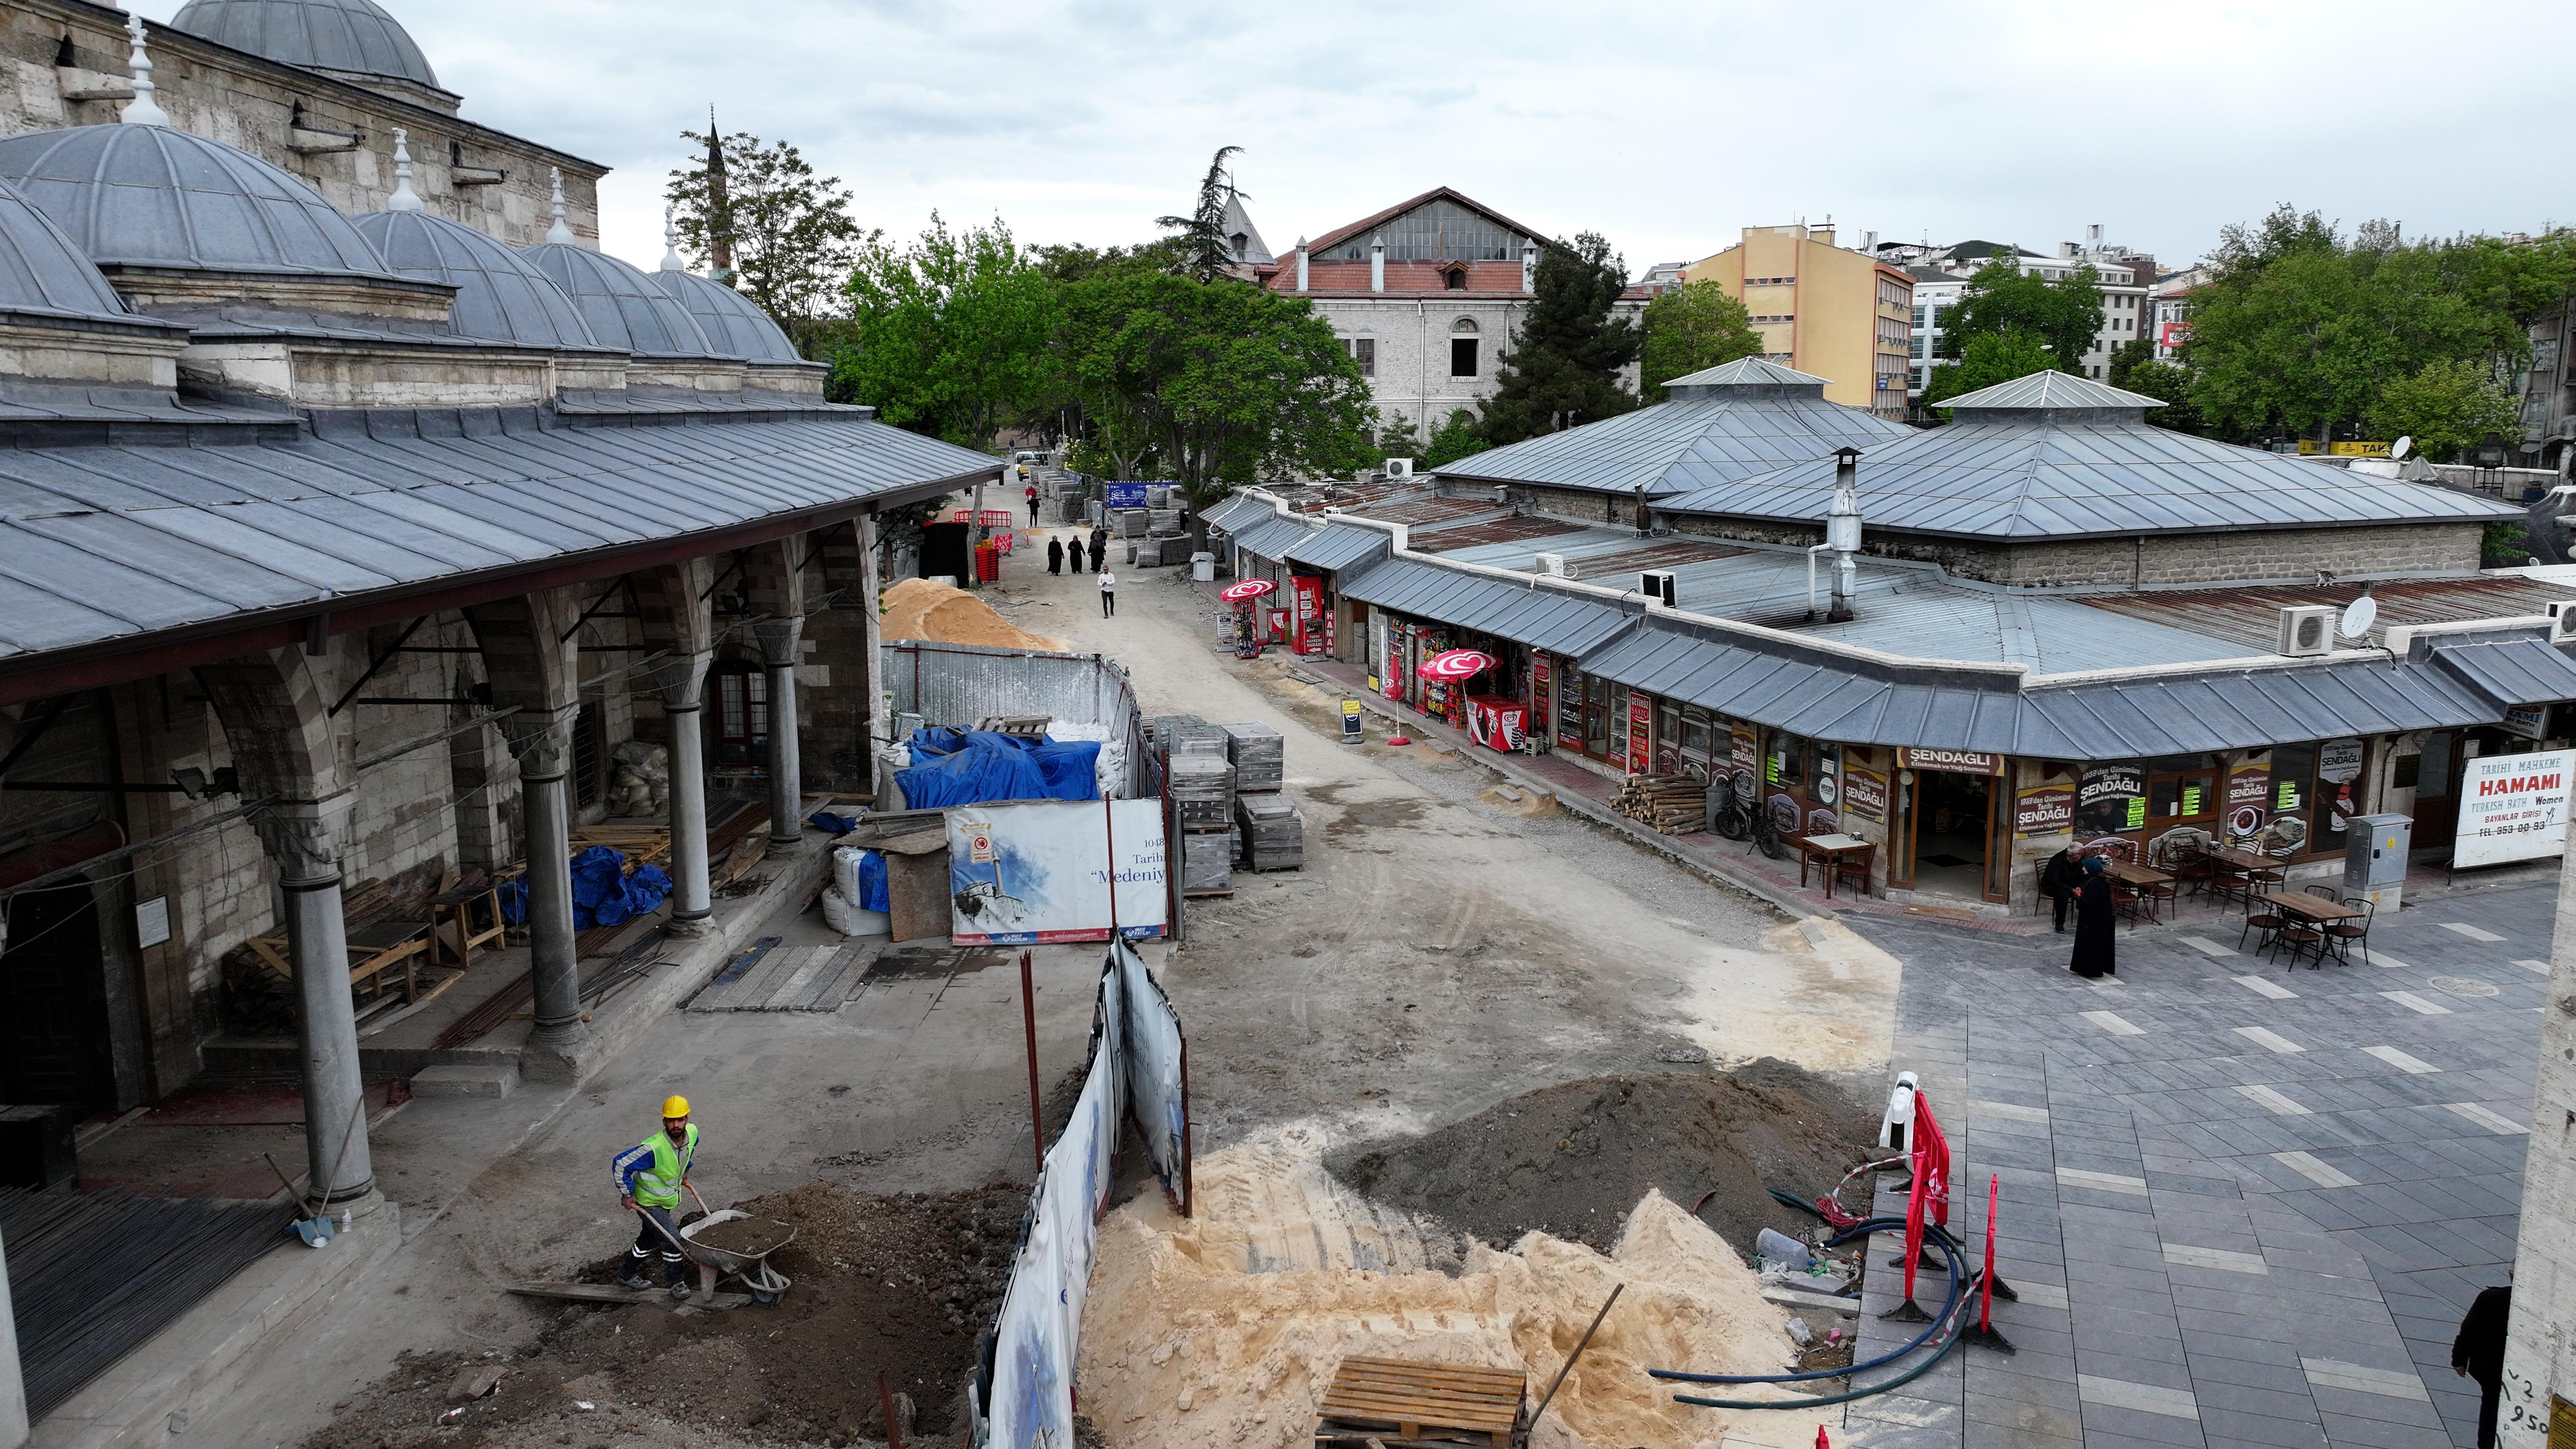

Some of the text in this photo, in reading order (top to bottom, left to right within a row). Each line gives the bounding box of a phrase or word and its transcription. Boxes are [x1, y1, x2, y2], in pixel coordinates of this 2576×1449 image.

[1632, 697, 1649, 709] ÇETİNÖZ
[1631, 707, 1649, 718] SAATÇİ
[2516, 718, 2535, 728] BATH
[1910, 749, 1990, 765] ŞENDAĞLI
[2321, 753, 2360, 767] ŞENDAĞLI
[2082, 766, 2140, 781] 1939'dan Günümüze
[2481, 758, 2561, 775] TARİHİ MAHKEME
[1859, 783, 1871, 792] Tarihi
[2080, 777, 2140, 800] ŞENDAĞLI
[2229, 785, 2268, 799] ŞENDAĞLI
[2479, 773, 2560, 796] HAMAMI
[1845, 786, 1883, 807] ŞENDAĞLI
[2021, 797, 2043, 805] 1939'dan
[2471, 796, 2563, 813] TURKISH BATH Women
[2019, 806, 2071, 825] ŞENDAĞLI
[2484, 808, 2542, 823] BAYANLAR GİRİŞİ
[2479, 821, 2545, 837] TEL. 353 00 93
[1145, 838, 1165, 848] 1048
[1133, 852, 1166, 864] Tarihi
